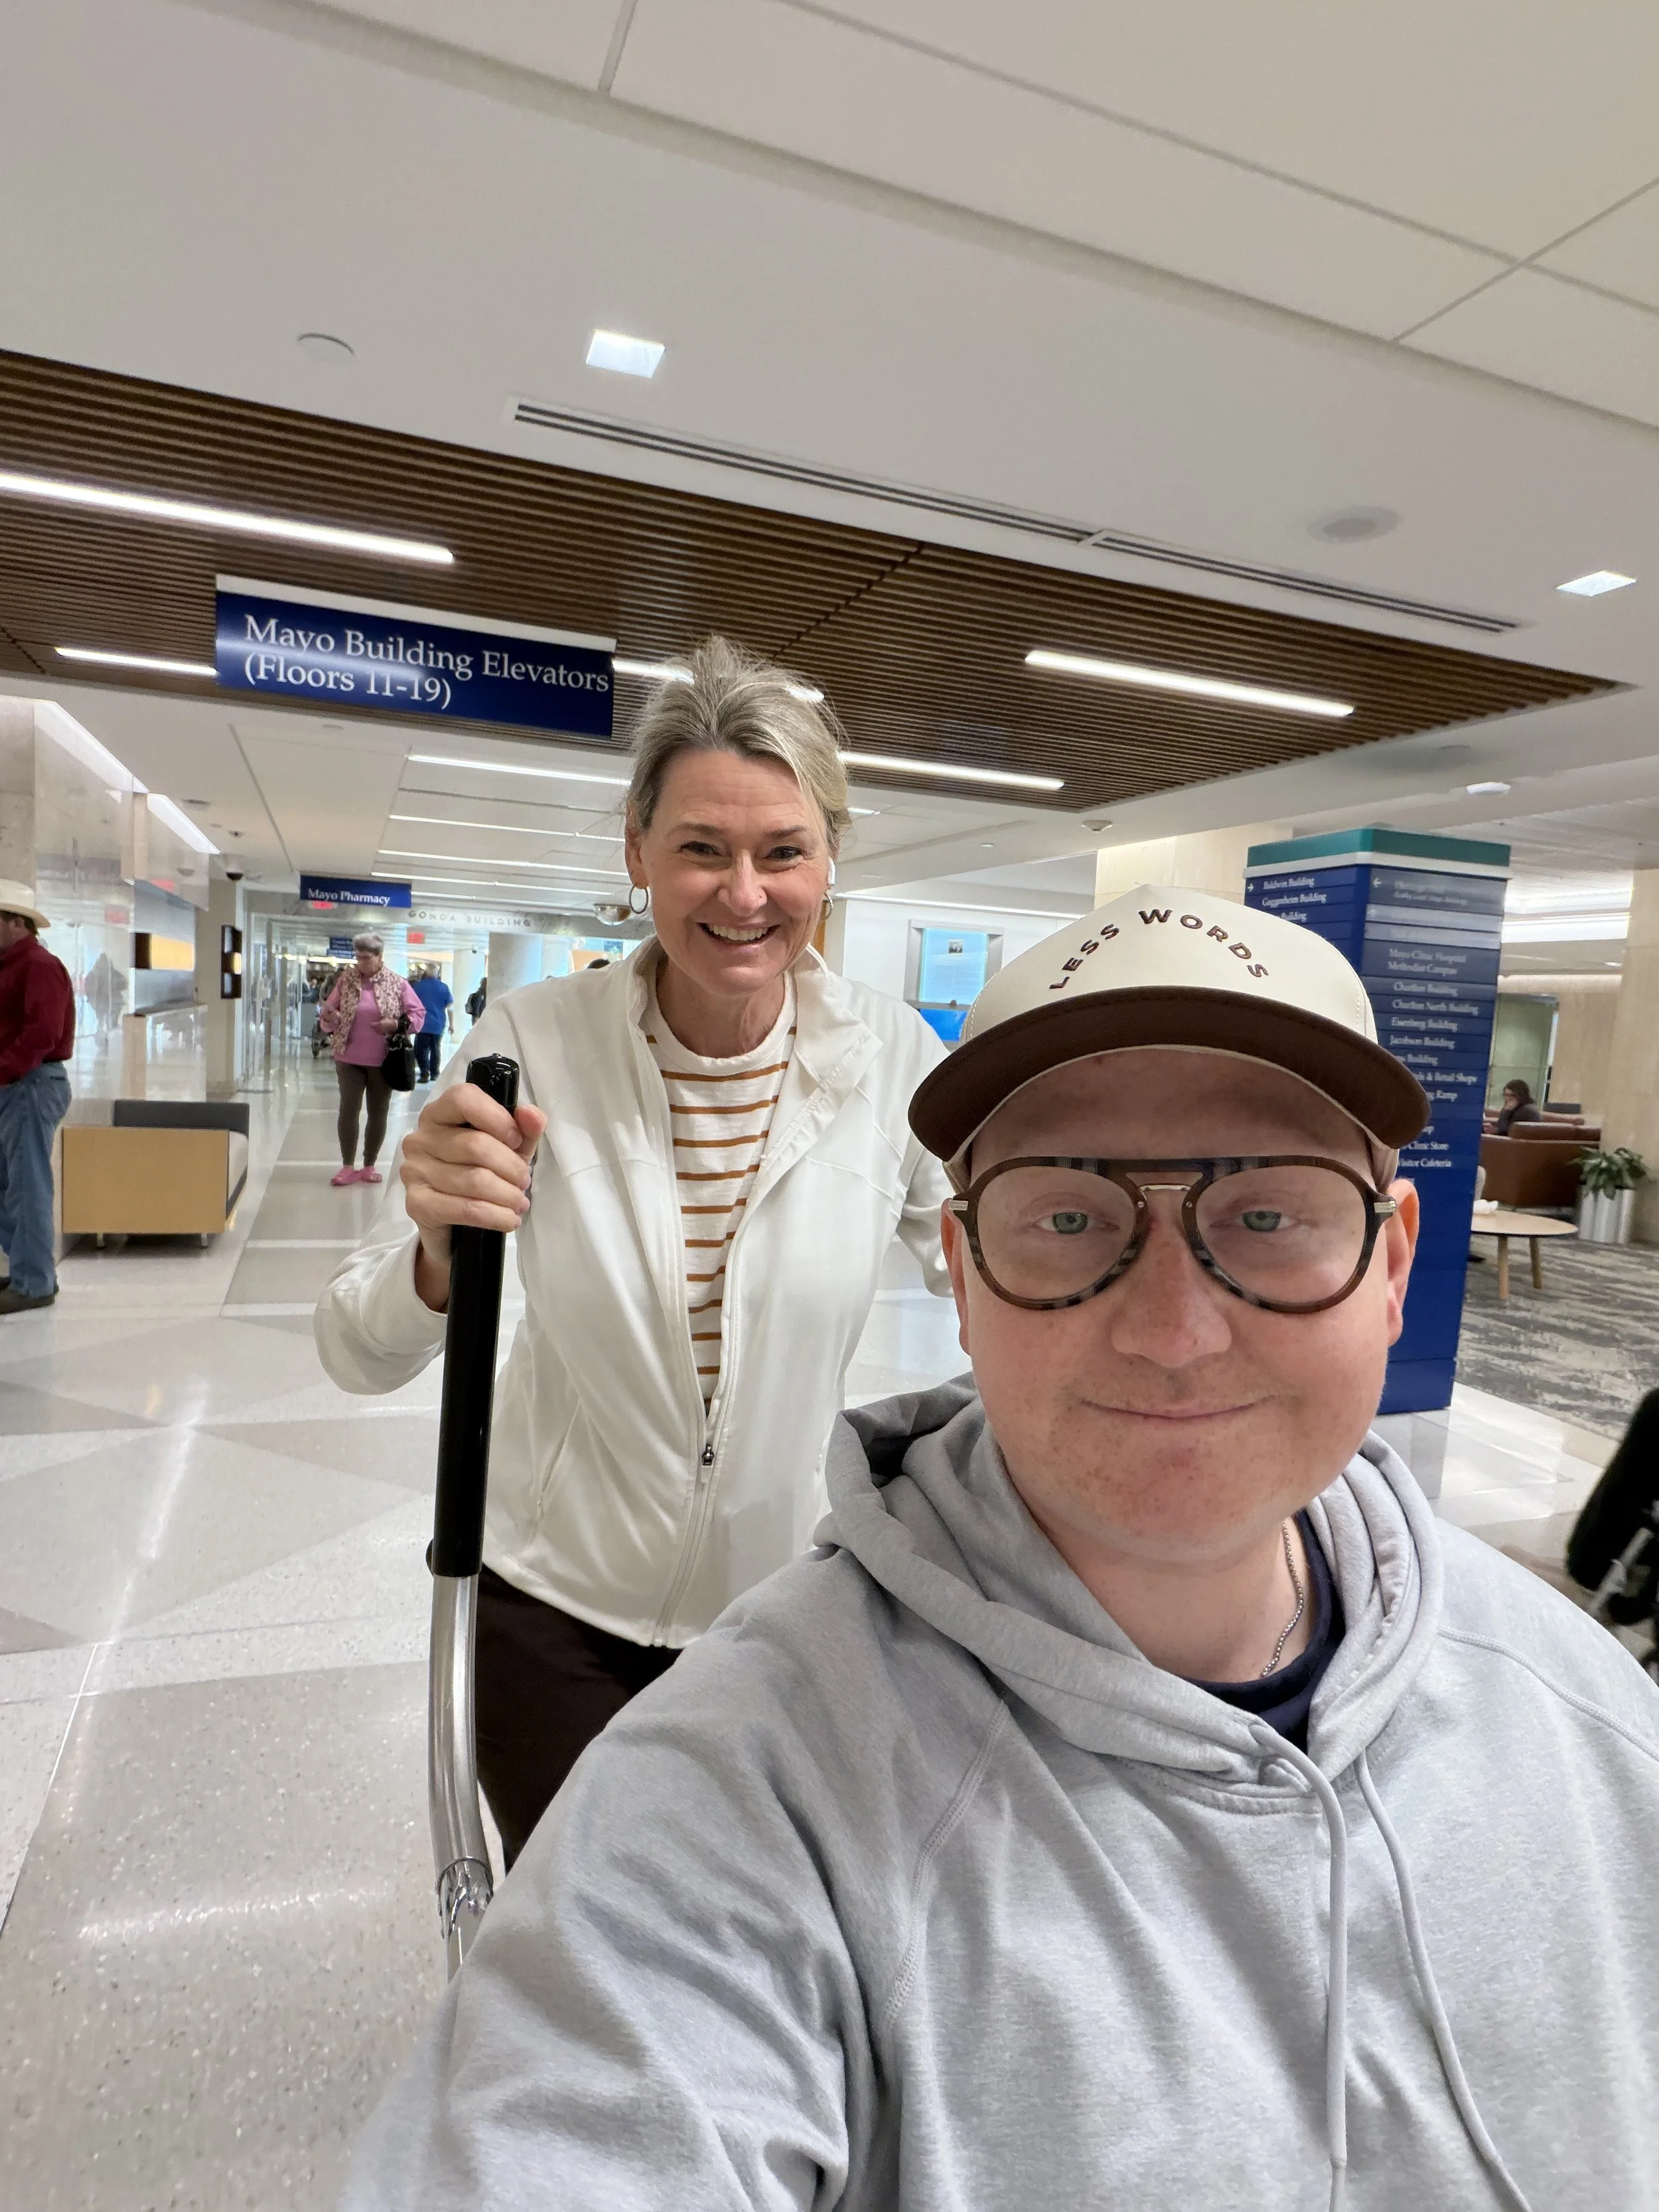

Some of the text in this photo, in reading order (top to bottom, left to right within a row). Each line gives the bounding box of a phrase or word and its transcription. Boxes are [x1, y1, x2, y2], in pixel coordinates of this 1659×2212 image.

[244, 614, 609, 692] Mayo Building Elevators
[245, 652, 451, 710] (Floors 11-19)
[308, 888, 337, 902] Mayo
[340, 890, 391, 907] Pharmacy
[466, 915, 532, 927] BUILDING
[1048, 909, 1269, 990] LESS WORDS
[1430, 1141, 1449, 1150] Store
[1420, 1158, 1452, 1168] Cafeteria
